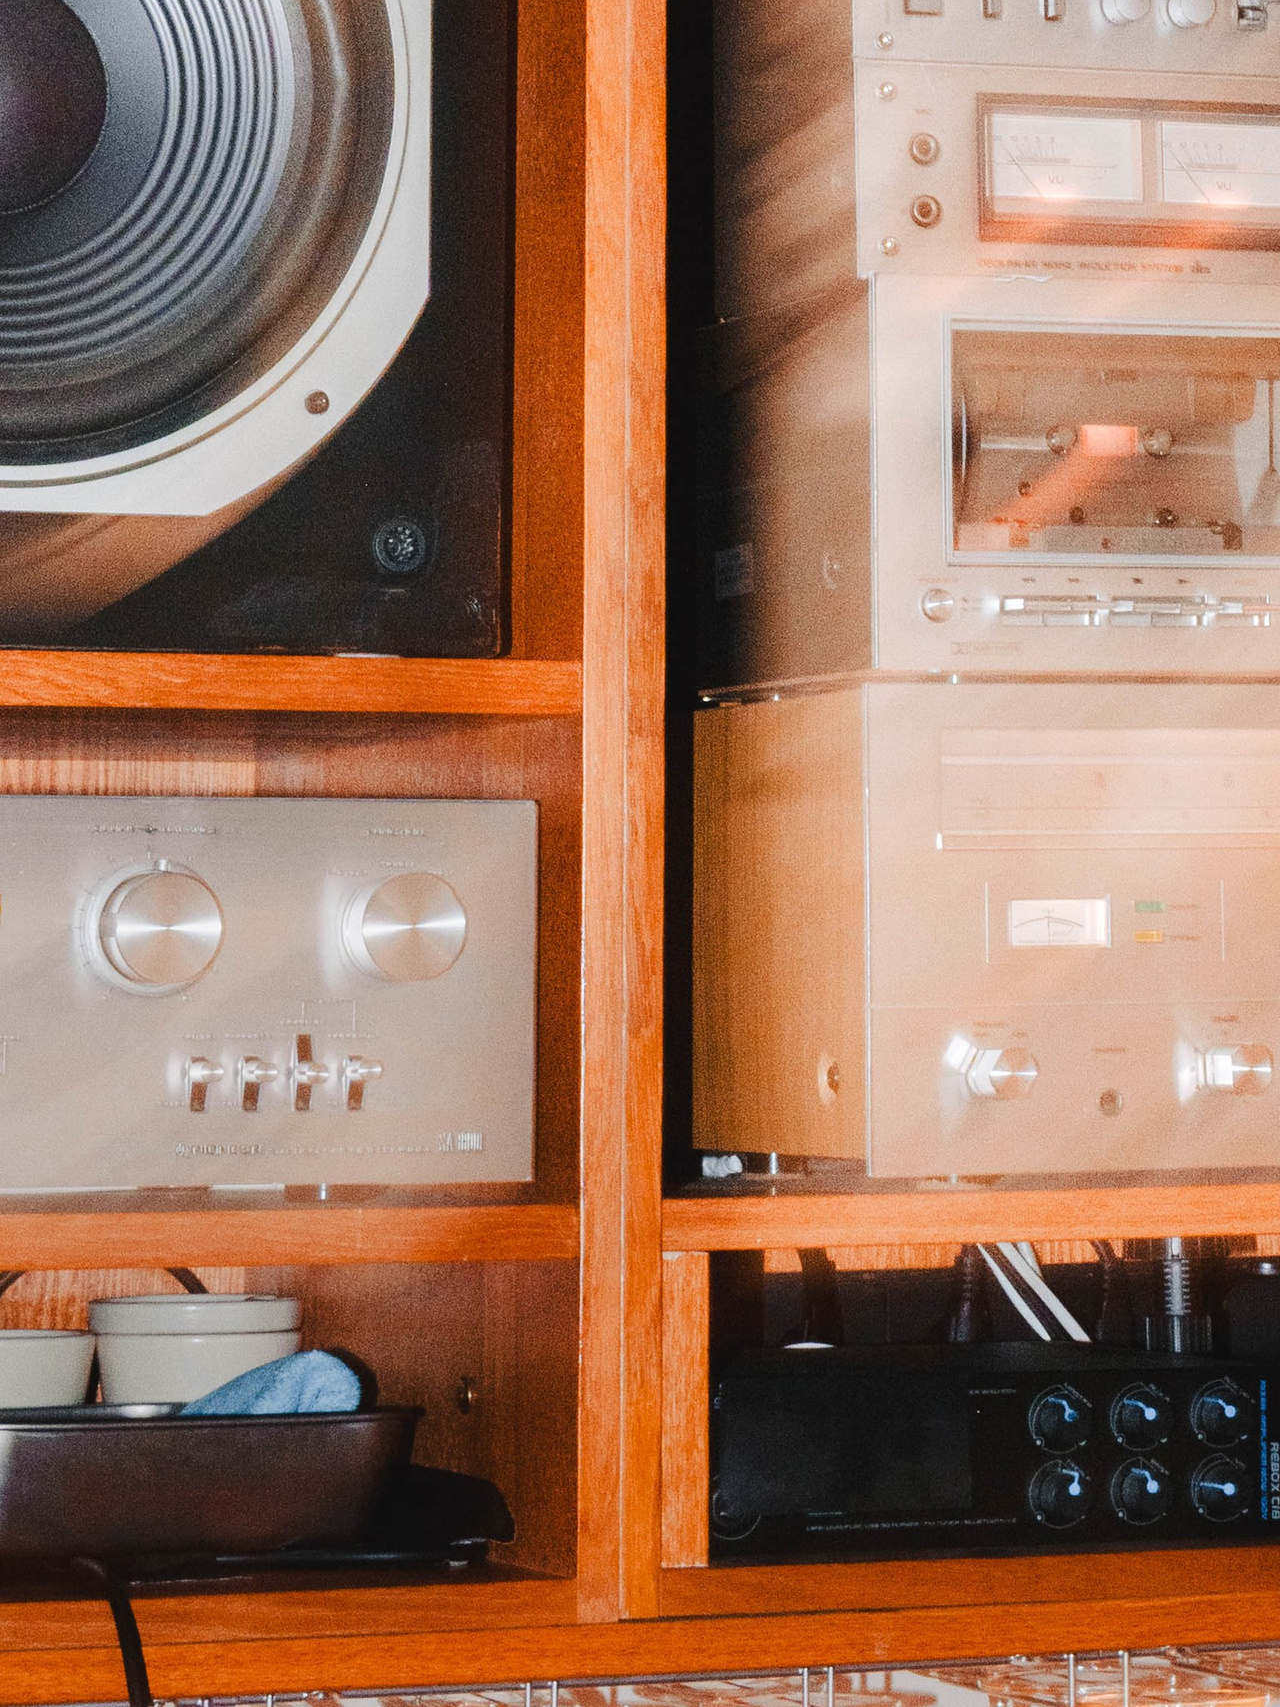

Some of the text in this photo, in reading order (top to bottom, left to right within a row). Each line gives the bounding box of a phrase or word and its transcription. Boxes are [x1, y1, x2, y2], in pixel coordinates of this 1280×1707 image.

[1048, 175, 1064, 186] VU
[1216, 181, 1232, 191] VU
[1270, 1441, 1280, 1492] REBOX
